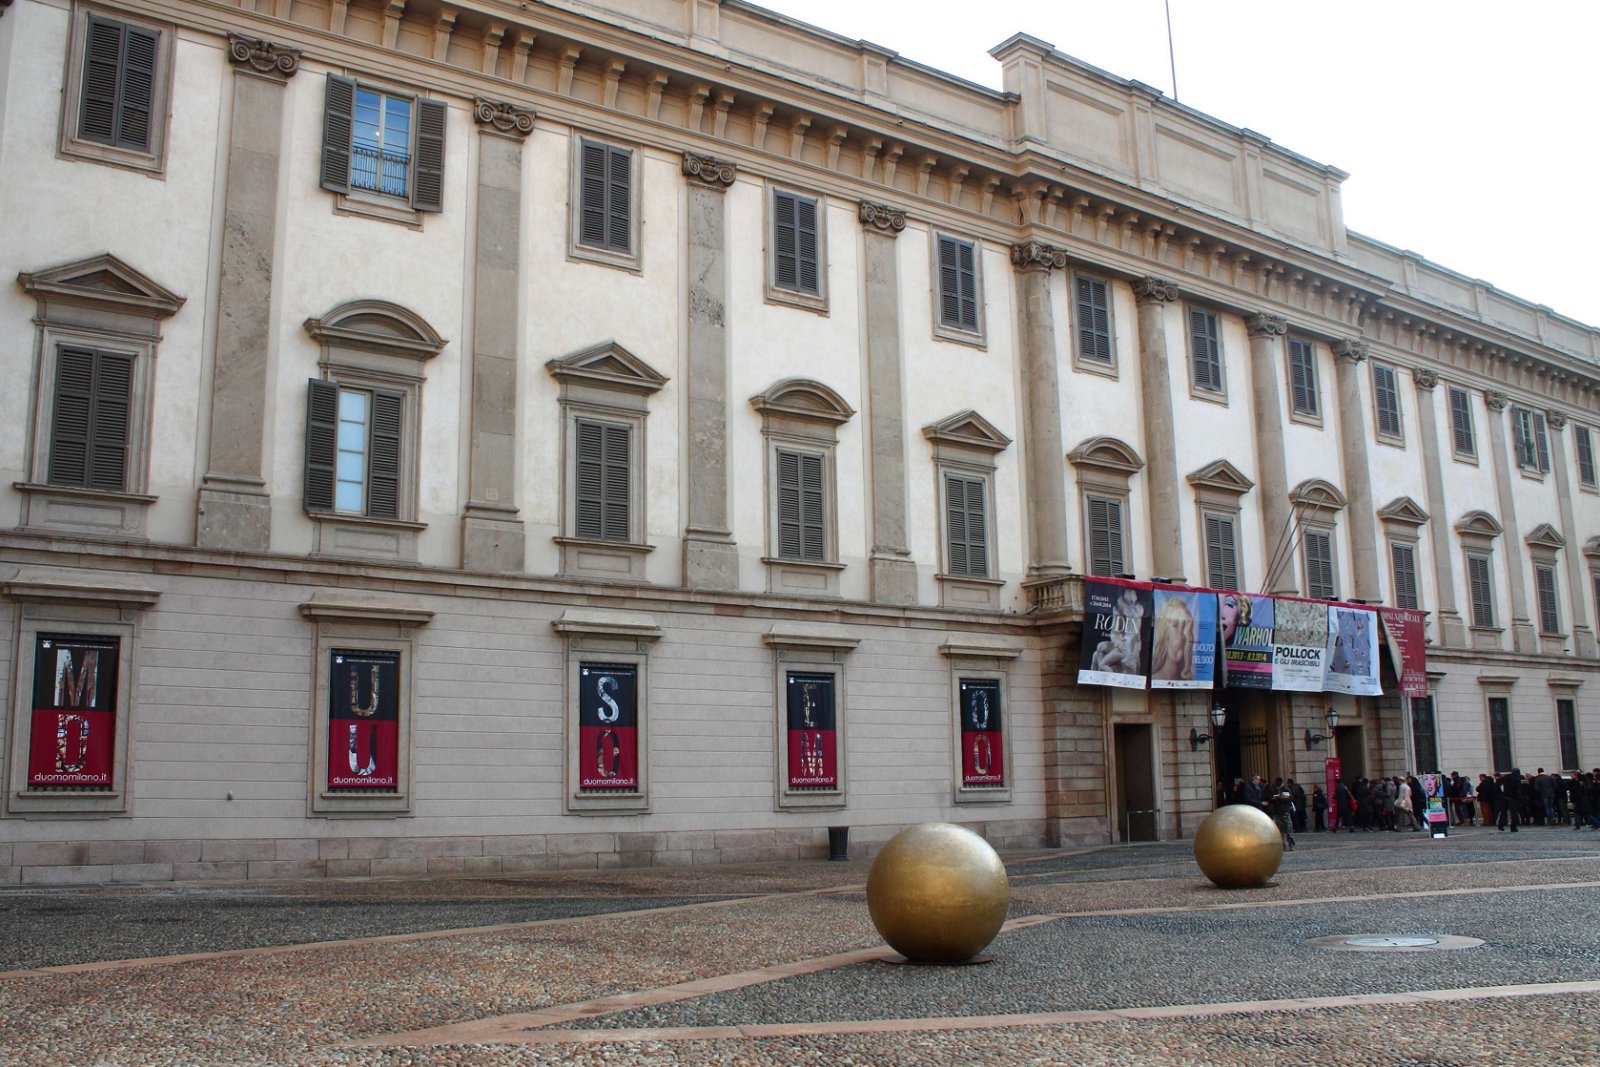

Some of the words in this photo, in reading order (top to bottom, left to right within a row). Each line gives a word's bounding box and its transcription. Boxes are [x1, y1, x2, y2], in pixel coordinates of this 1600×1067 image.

[1094, 613, 1139, 634] RODIN
[1233, 627, 1274, 648] WARHOL
[1275, 646, 1321, 660] POLLOCK
[1290, 659, 1321, 667] IRASCIBILI
[54, 649, 98, 708] M
[350, 664, 380, 717] U
[597, 676, 620, 724] S
[971, 690, 989, 729] O
[348, 724, 378, 776] U
[596, 729, 620, 777] O
[34, 773, 107, 783] duomomilano.it
[333, 776, 393, 784] duomomilano.it
[583, 778, 634, 786] duomomilano.it
[792, 776, 834, 784] duomomilano.it
[965, 774, 1001, 782] duomomilano.it
